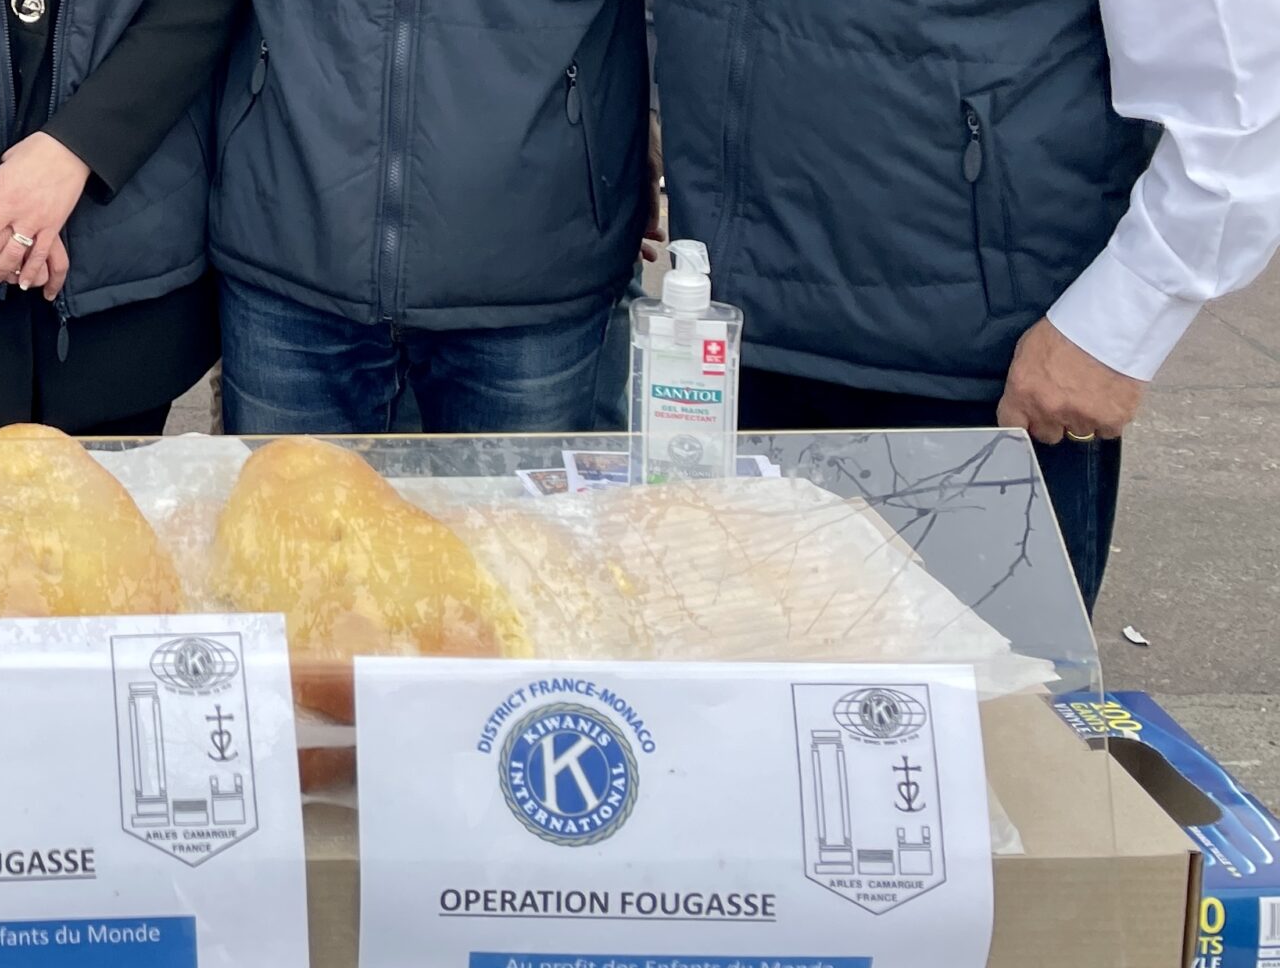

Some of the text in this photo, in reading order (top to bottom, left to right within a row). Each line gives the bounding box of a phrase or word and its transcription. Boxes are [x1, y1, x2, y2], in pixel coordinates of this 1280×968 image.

[655, 386, 720, 403] SANYTOL
[661, 404, 710, 416] GEL MAINS
[477, 677, 656, 754] DISTRICT FRANCE-MONACO
[1053, 703, 1092, 733] VINYLE
[1070, 702, 1111, 732] GANTS
[1089, 700, 1143, 731] 100
[523, 714, 612, 747] KIWANIS
[540, 732, 601, 815] K
[510, 760, 626, 833] INTERNATIONAL
[146, 829, 237, 841] ARLES CAMARGUE
[171, 843, 211, 853] FRANCE
[829, 879, 925, 890] ARLES CAMARGUE
[856, 893, 898, 902] FRANCE
[439, 888, 777, 917] OPERATION FOUGASSE
[55, 924, 81, 946] du
[88, 923, 161, 944] Monde
